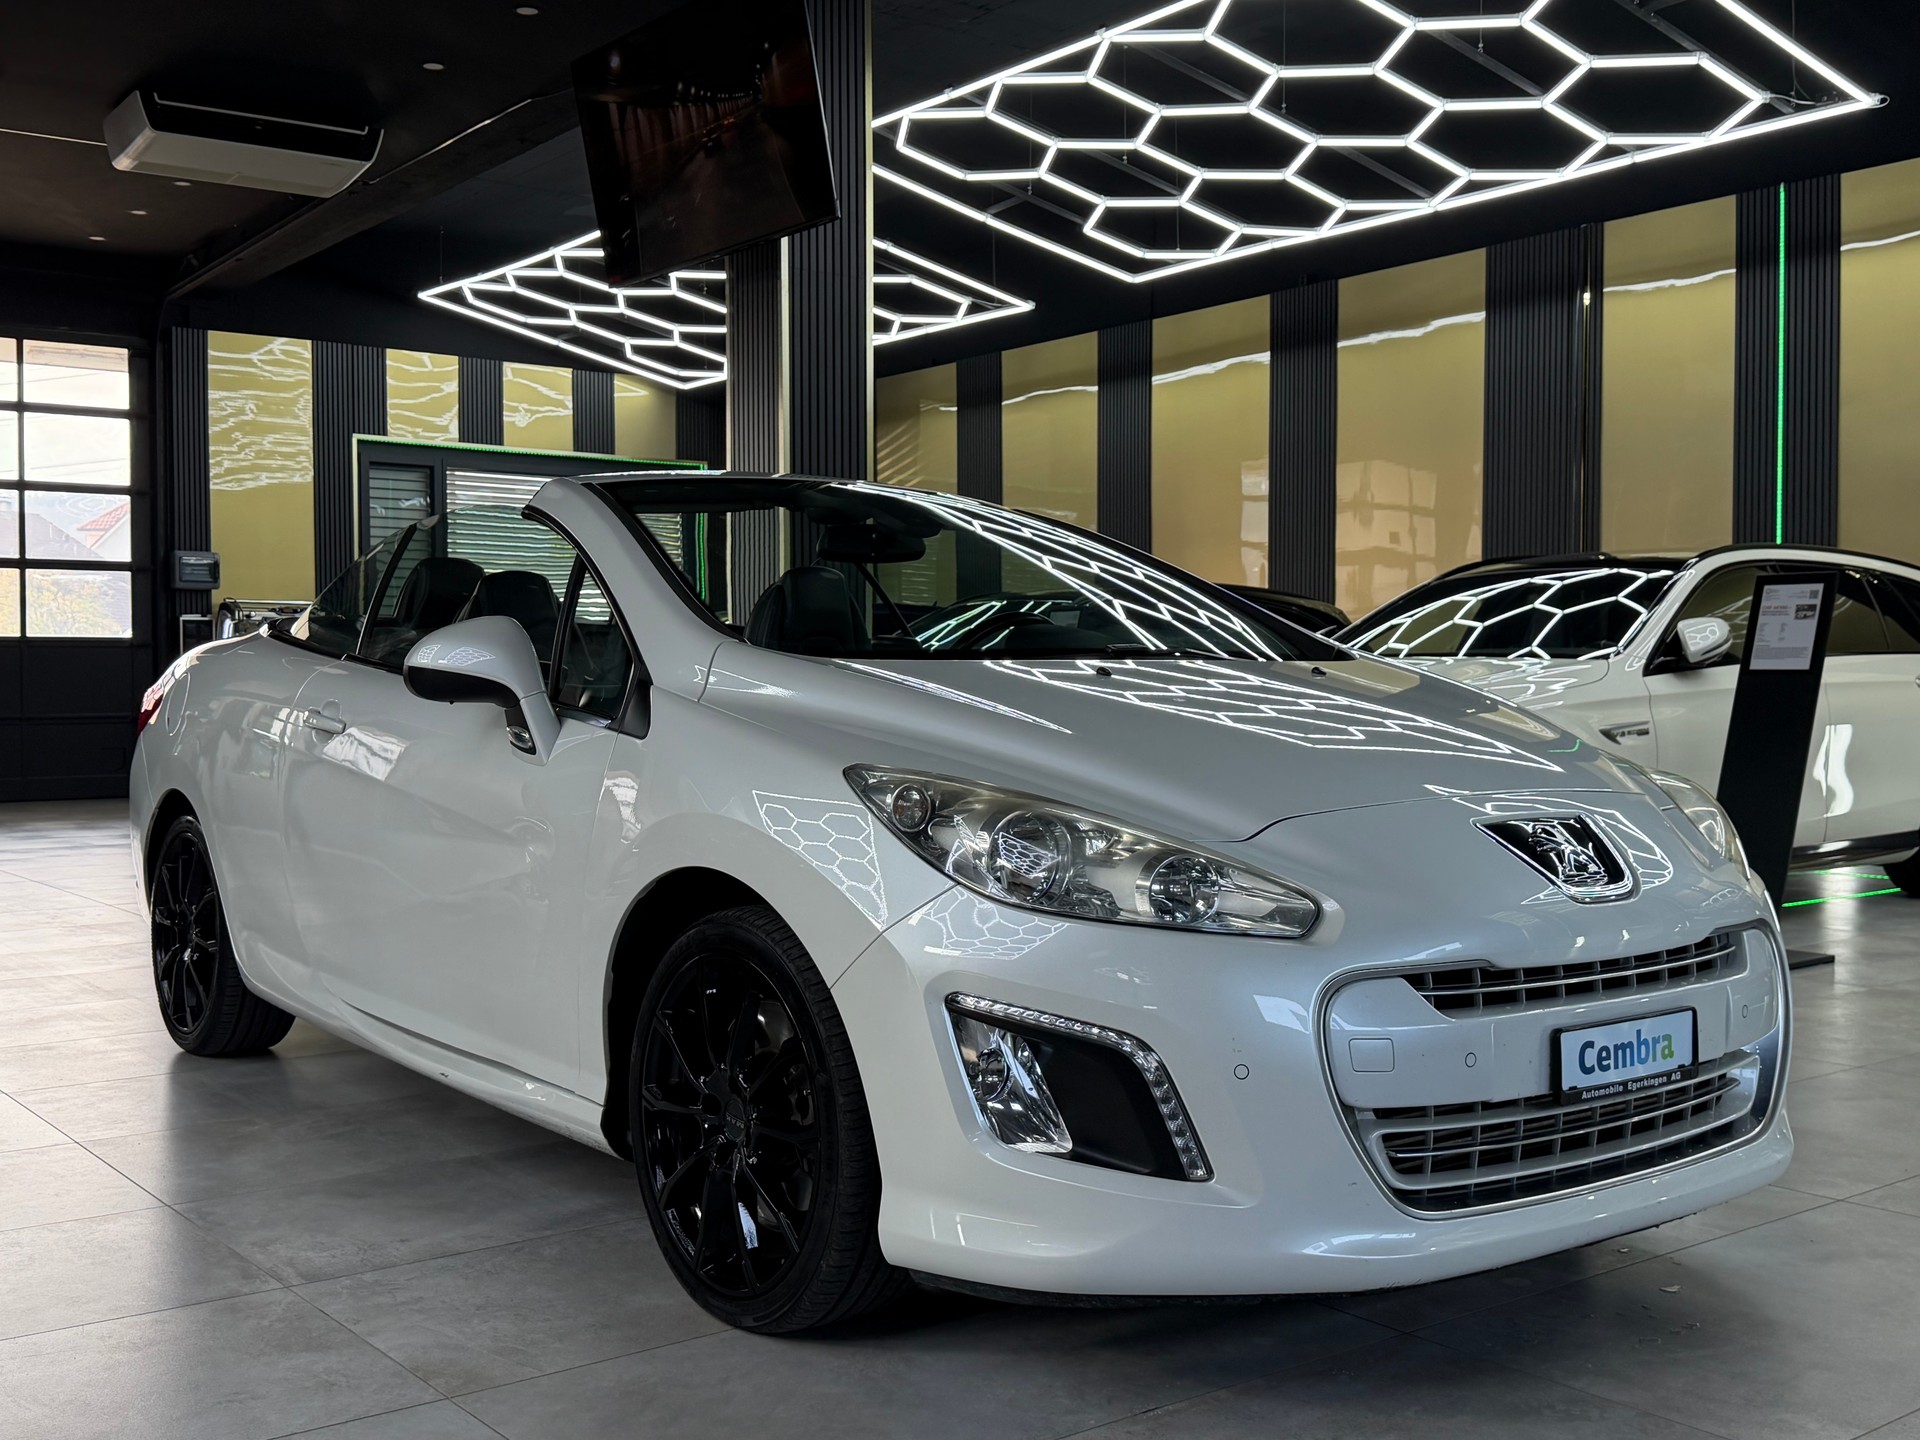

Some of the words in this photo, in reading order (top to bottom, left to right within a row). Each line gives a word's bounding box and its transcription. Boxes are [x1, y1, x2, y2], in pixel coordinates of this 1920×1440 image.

[1578, 1029, 1675, 1076] Cembra
[1582, 1085, 1624, 1099] Automobile
[1627, 1076, 1667, 1091] Egerkingen
[1671, 1072, 1681, 1081] AG
